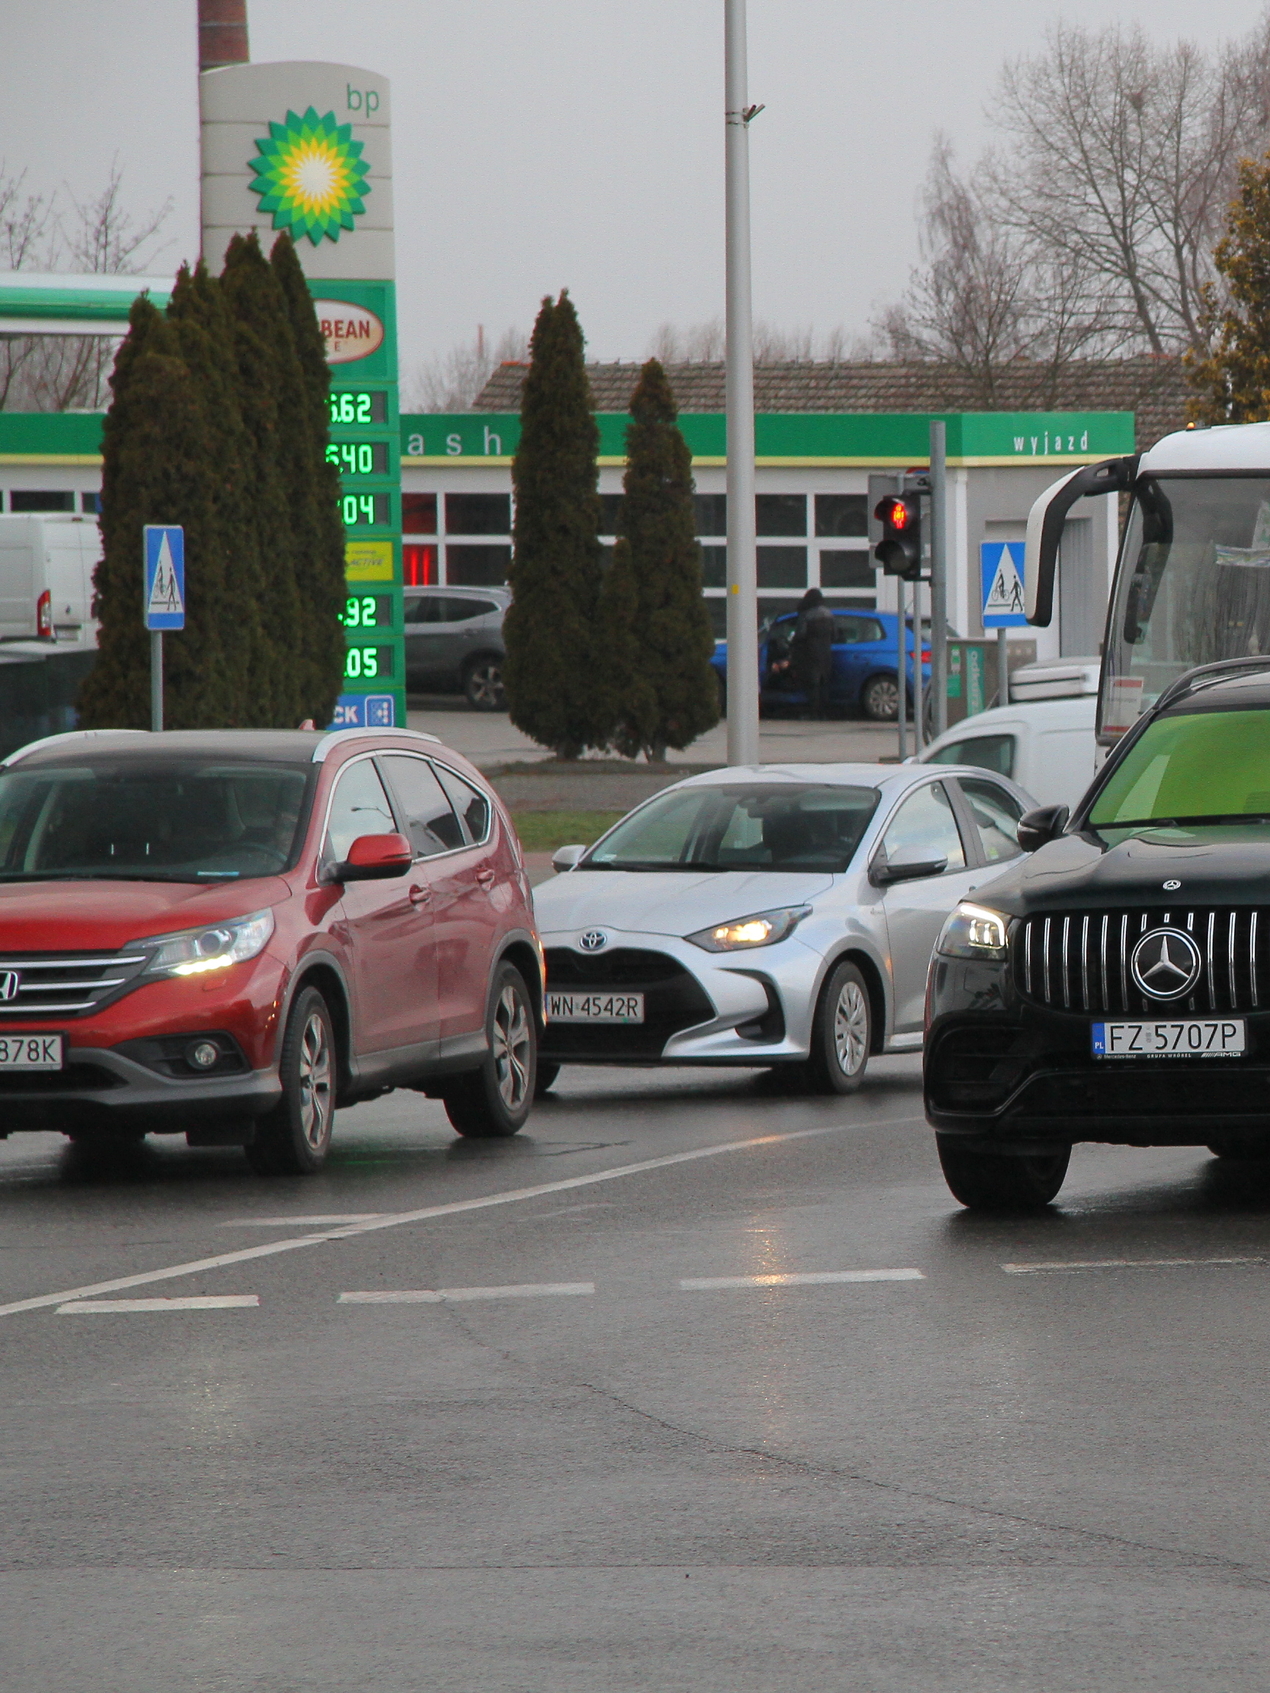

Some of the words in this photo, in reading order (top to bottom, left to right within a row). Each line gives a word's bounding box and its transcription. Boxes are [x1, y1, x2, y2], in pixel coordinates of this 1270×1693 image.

[347, 83, 380, 119] bp
[320, 319, 370, 339] BEAN
[407, 424, 502, 456] ash
[1013, 430, 1088, 456] wyjazd
[551, 996, 573, 1016] WN
[581, 996, 638, 1017] 4542R
[1094, 1042, 1104, 1050] PL
[1110, 1024, 1143, 1052] FZ
[1154, 1023, 1238, 1051] 5707P
